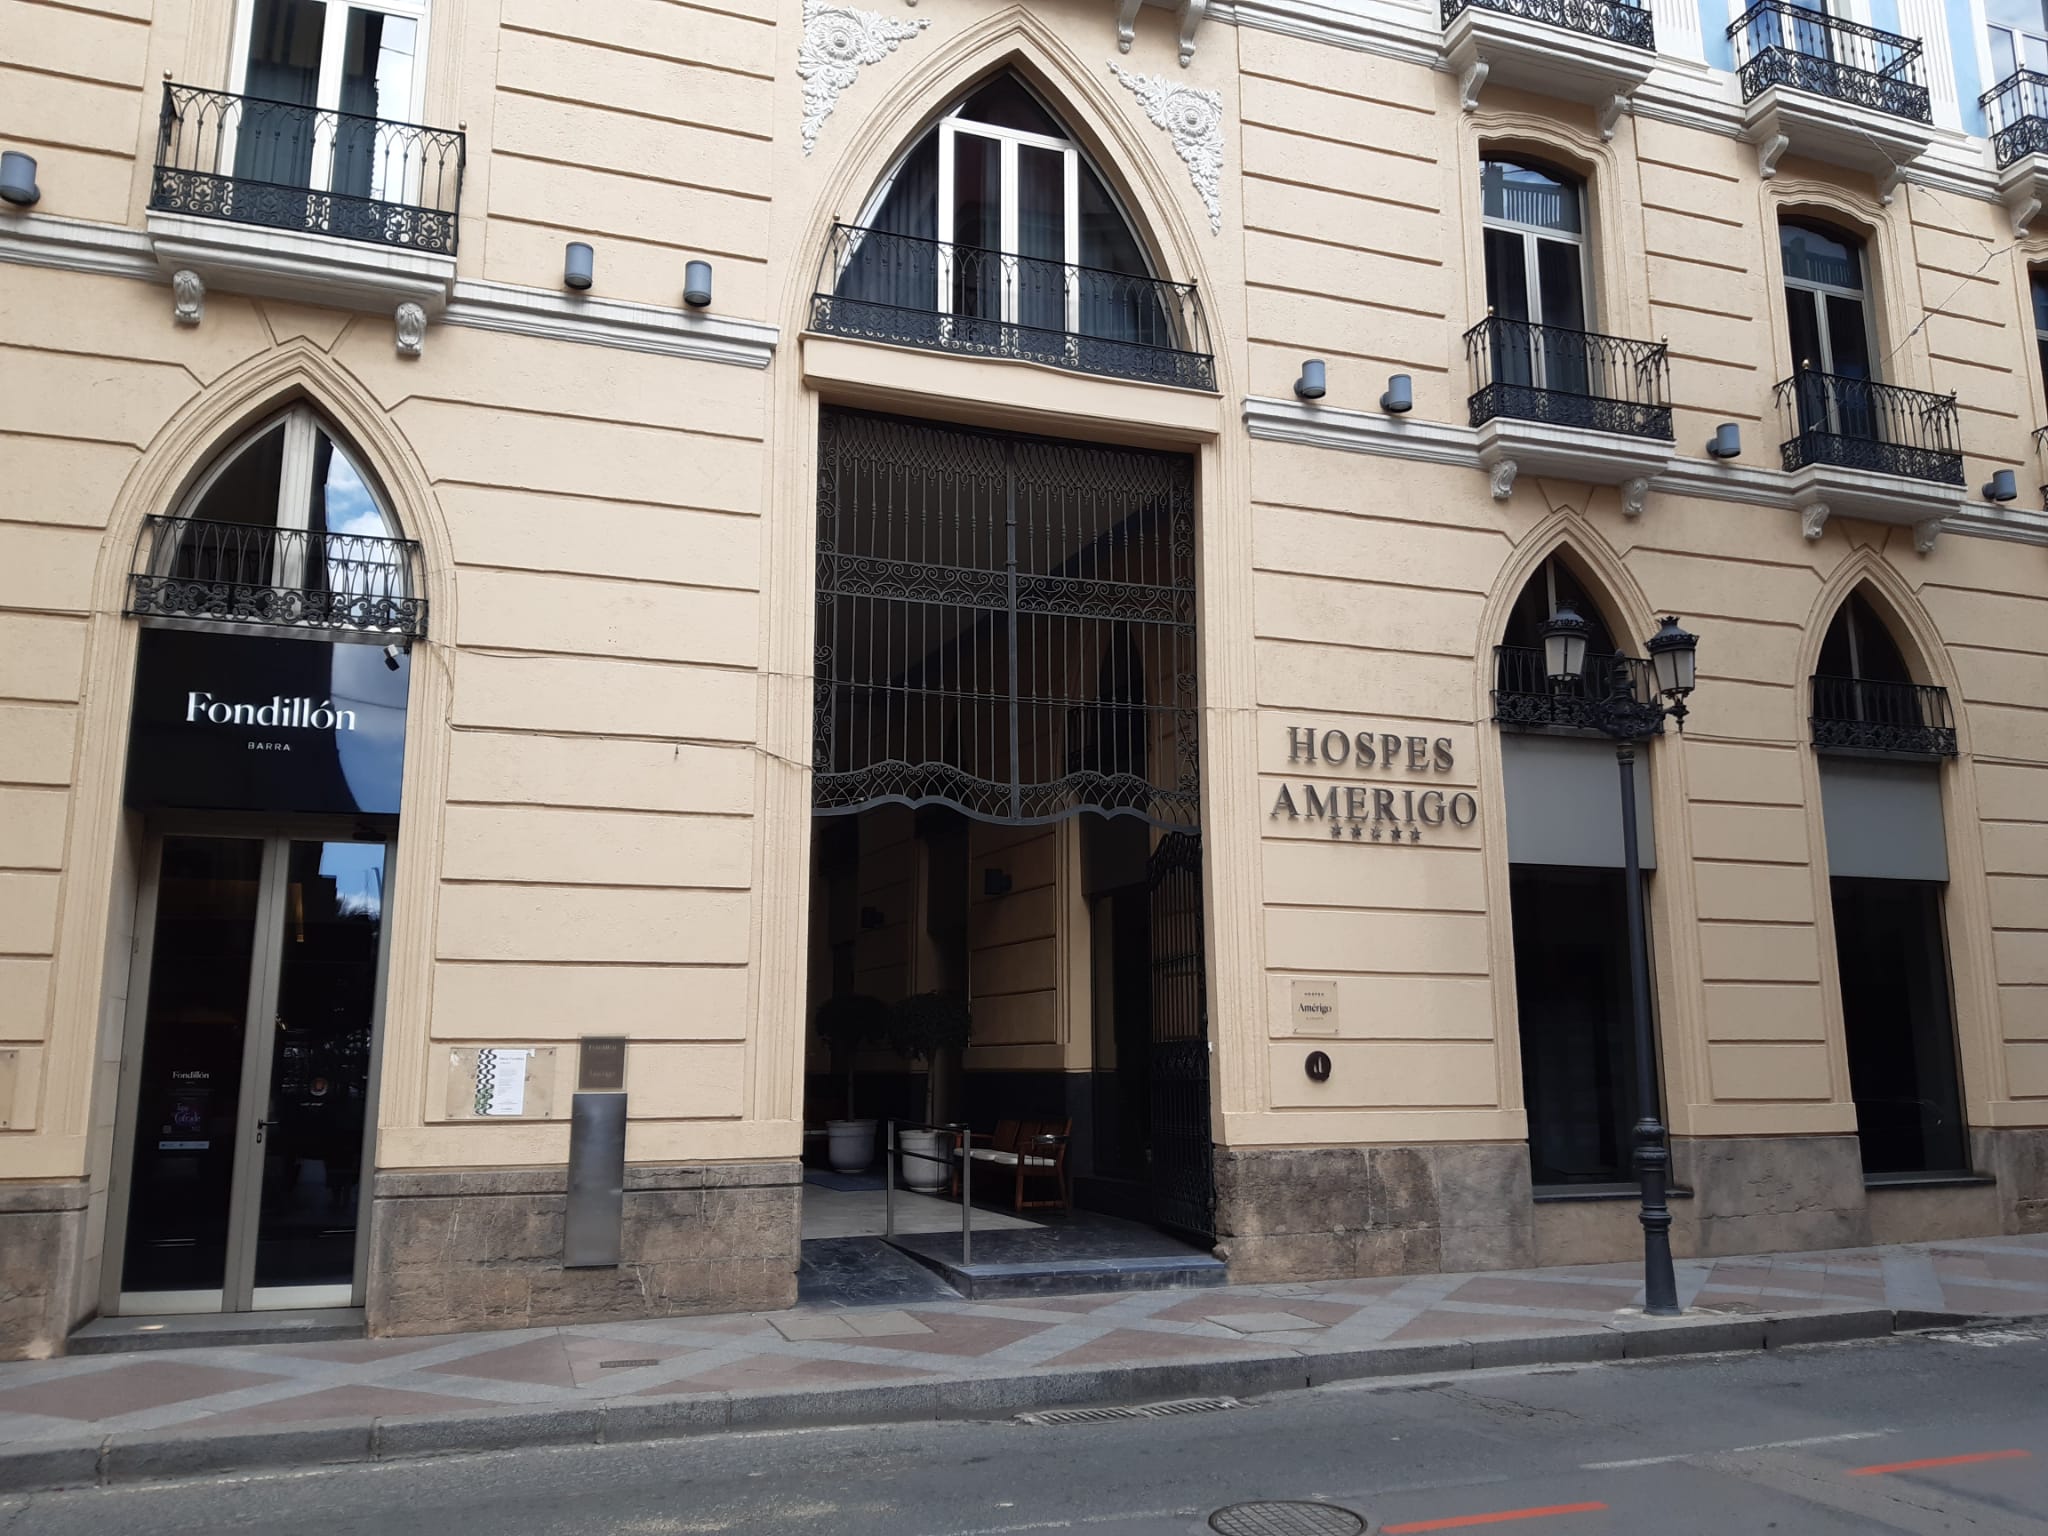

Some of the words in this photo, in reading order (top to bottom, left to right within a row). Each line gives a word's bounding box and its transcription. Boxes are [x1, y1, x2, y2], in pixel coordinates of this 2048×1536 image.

[185, 691, 356, 731] Fondillón
[247, 741, 291, 752] BARRA
[1287, 726, 1455, 772] HOSPES
[1270, 783, 1477, 826] AMERIGO
